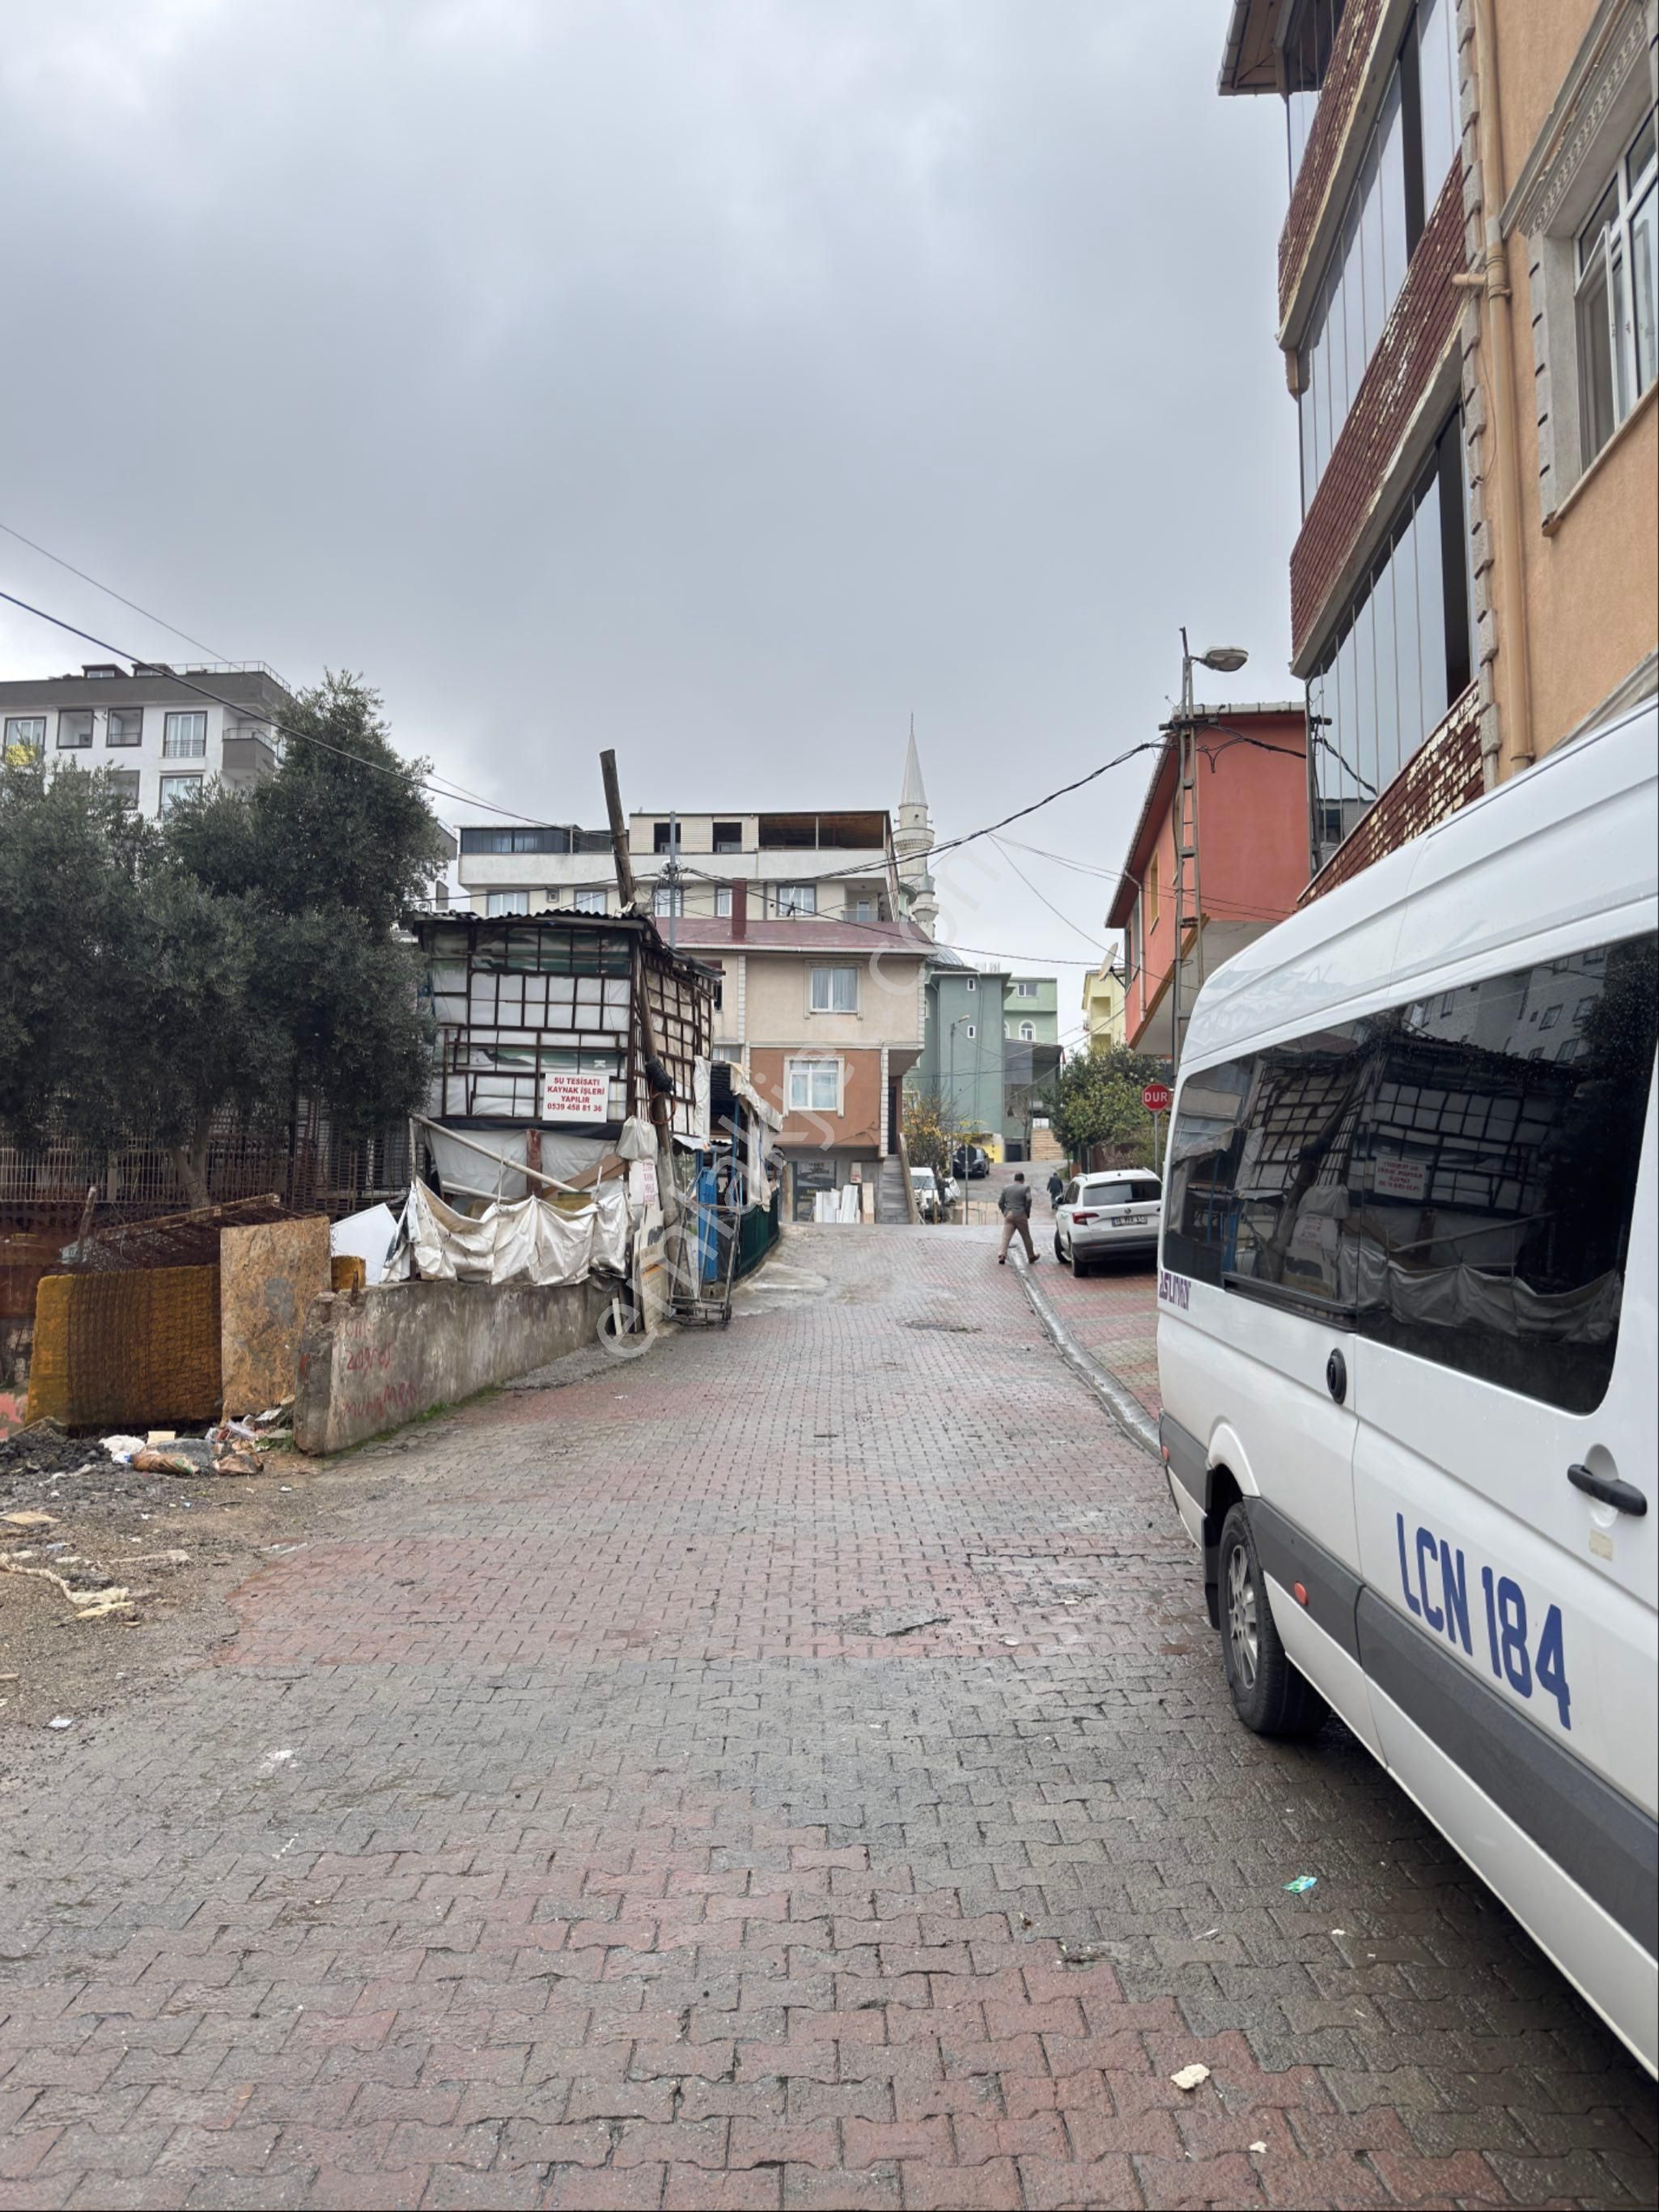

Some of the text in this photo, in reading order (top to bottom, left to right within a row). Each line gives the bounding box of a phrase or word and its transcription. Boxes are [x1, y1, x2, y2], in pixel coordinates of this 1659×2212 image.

[554, 1076, 600, 1086] SU TESİSATI
[580, 1086, 605, 1096] İŞLERİ
[561, 1095, 590, 1104] YAPILIR
[1144, 1091, 1168, 1102] DUR
[547, 1102, 565, 1110] 0539
[566, 1103, 580, 1111] 458
[1396, 1512, 1572, 1731] LCN 184
